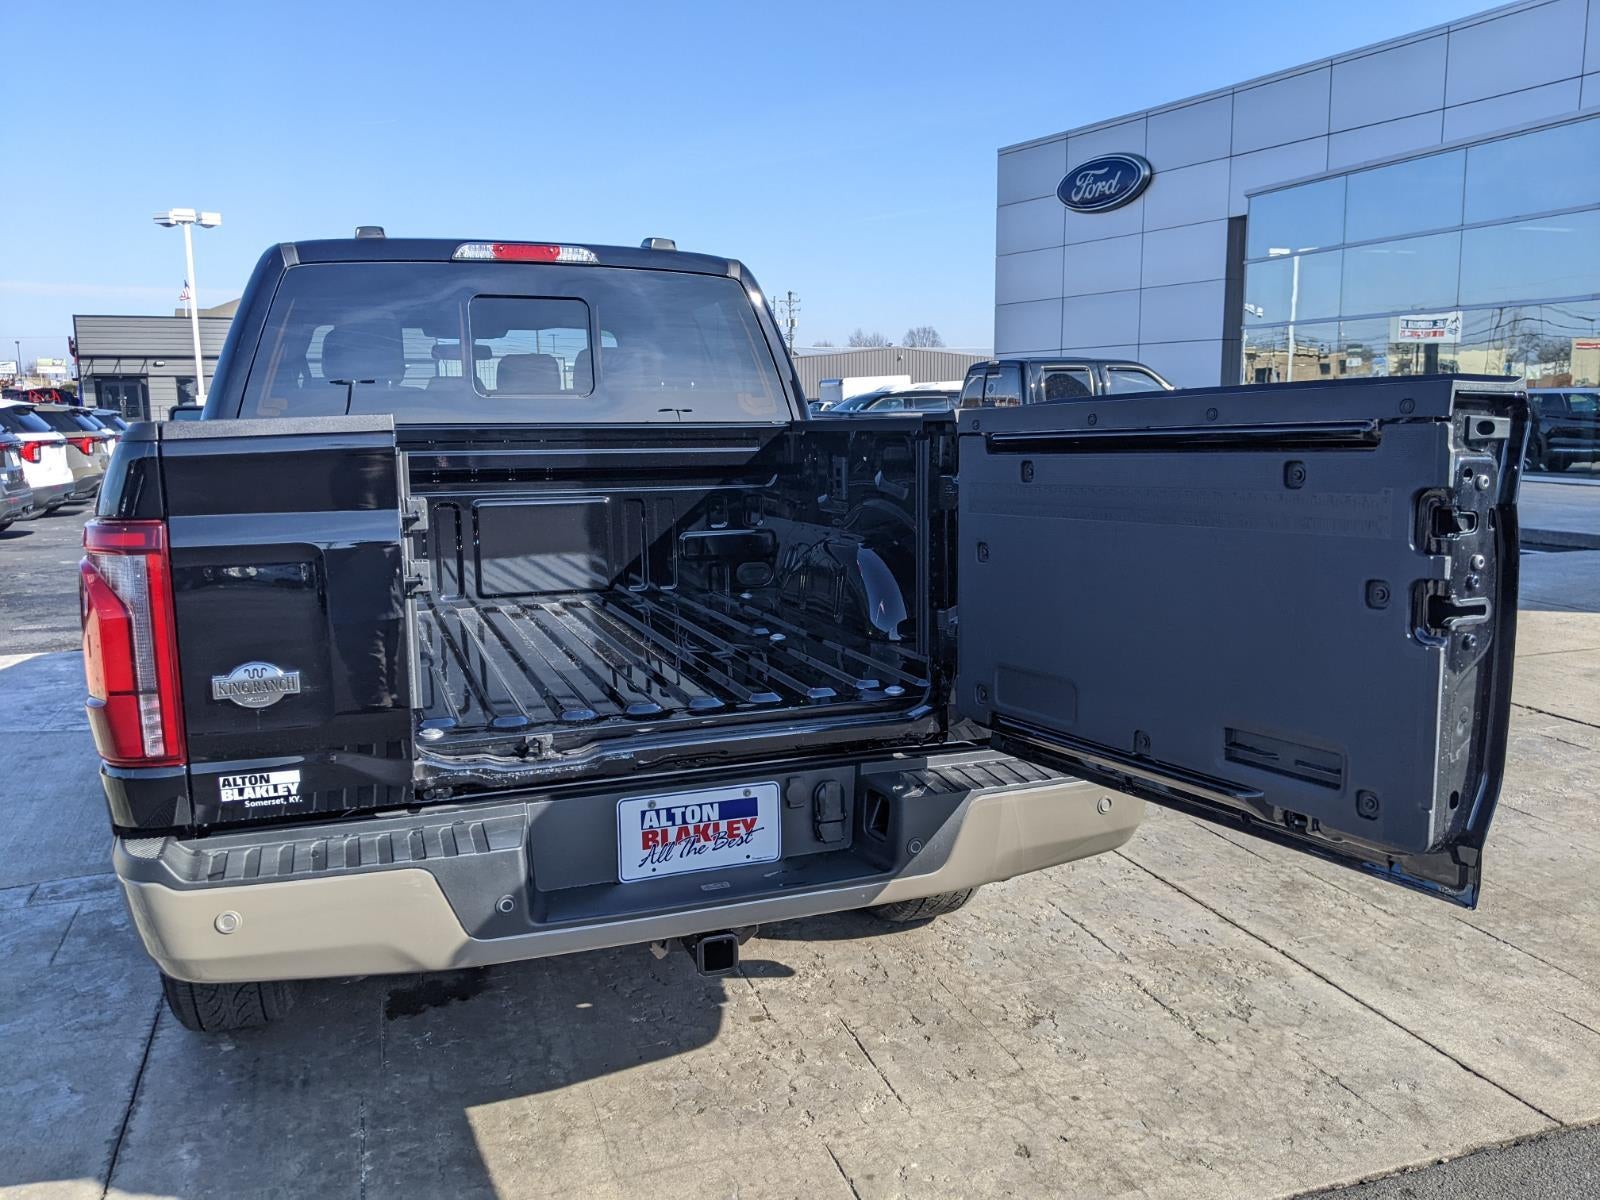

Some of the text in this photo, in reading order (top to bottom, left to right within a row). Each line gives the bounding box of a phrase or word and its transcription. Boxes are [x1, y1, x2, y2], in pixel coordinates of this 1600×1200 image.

[1071, 167, 1121, 202] Ford
[217, 676, 296, 697] KING RANCH
[221, 774, 271, 788] ALTON
[221, 782, 300, 801] BLAKLEY
[244, 795, 303, 808] Somerset, KY.
[643, 803, 719, 829] ALTON
[642, 817, 758, 850] BLAKLEY
[638, 827, 765, 868] All The Best
